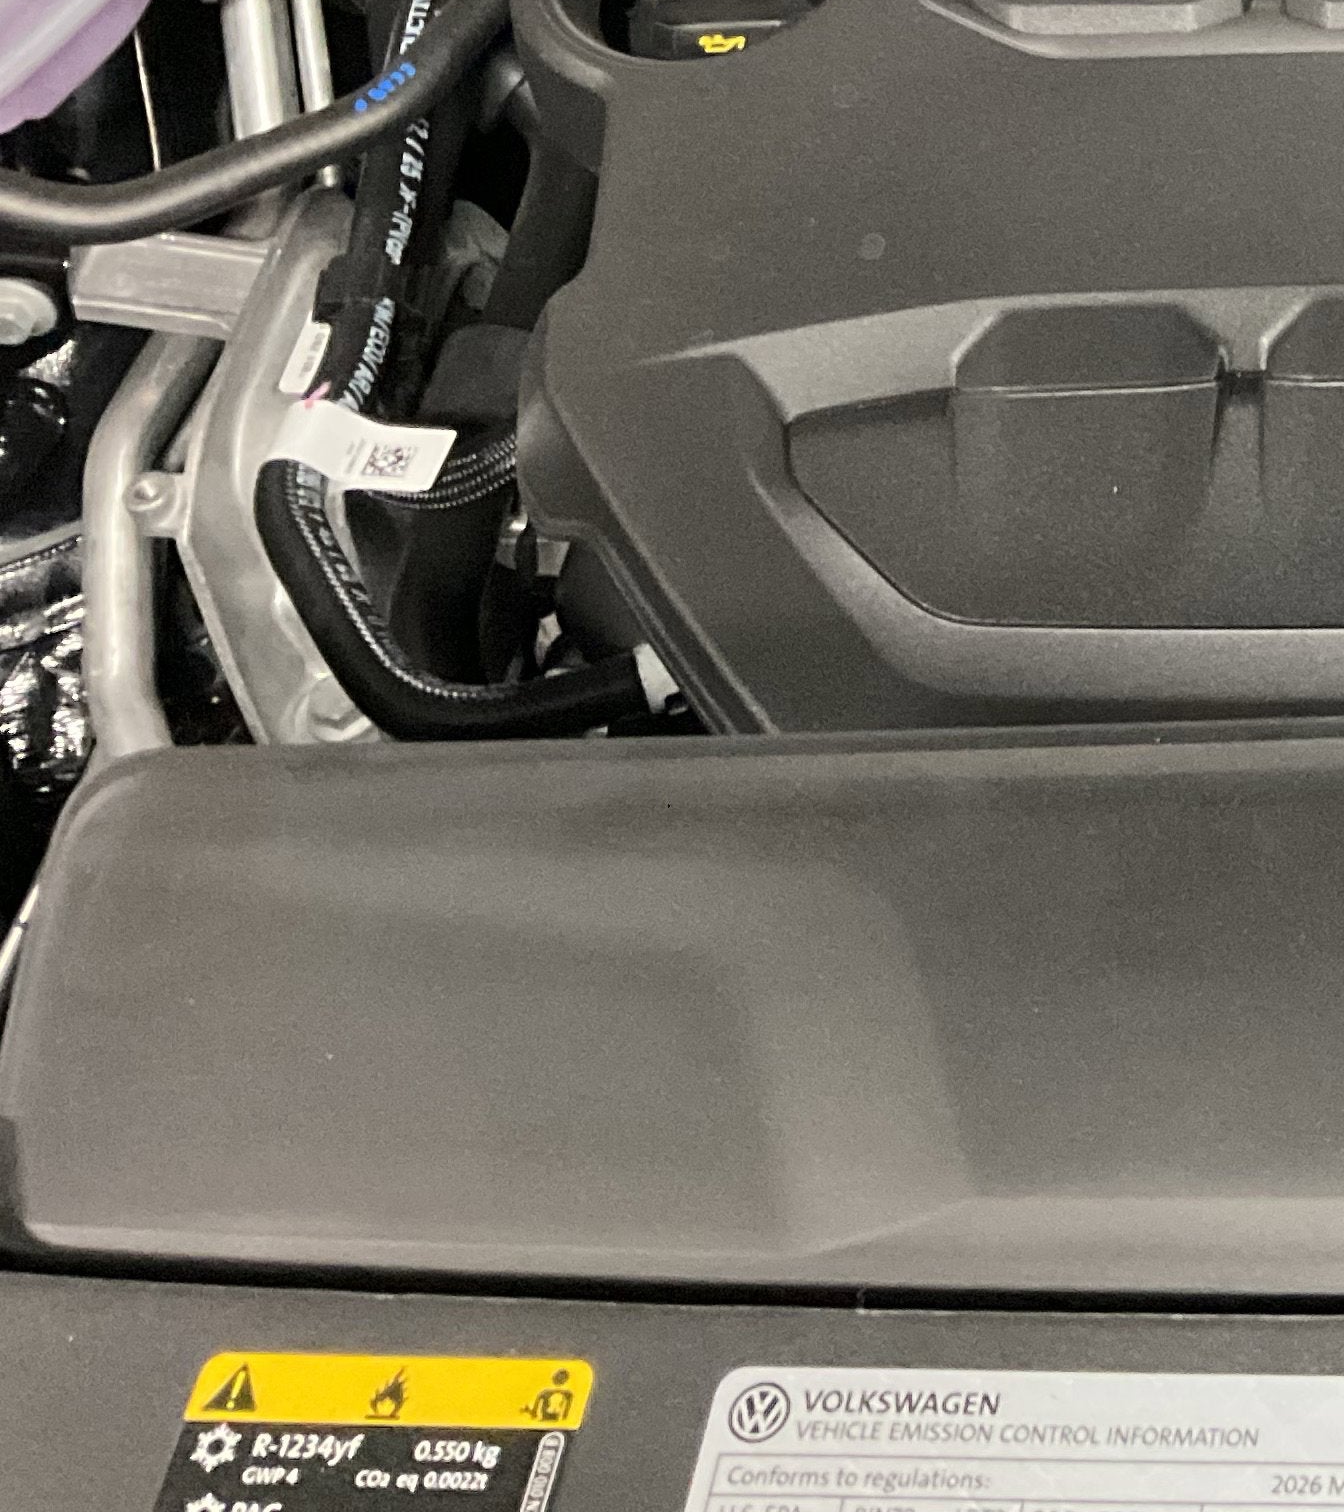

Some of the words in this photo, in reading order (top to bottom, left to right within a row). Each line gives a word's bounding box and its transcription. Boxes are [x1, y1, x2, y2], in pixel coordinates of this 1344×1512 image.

[804, 1390, 1000, 1416] VOLKSWAGEN
[797, 1419, 882, 1441] VEHICLE
[889, 1421, 993, 1443] EMISSION
[1000, 1423, 1099, 1446] CONTROL
[1106, 1426, 1260, 1448] INFORMATION
[252, 1433, 365, 1466] R-1234yf
[414, 1439, 470, 1462] 0.550
[472, 1440, 501, 1469] kg
[242, 1465, 286, 1485] GWP
[286, 1467, 300, 1486] 4
[396, 1473, 419, 1493] eq
[727, 1465, 827, 1488] Conforms
[836, 1468, 859, 1488] to
[864, 1469, 991, 1494] regulations:
[1271, 1475, 1323, 1496] 2026
